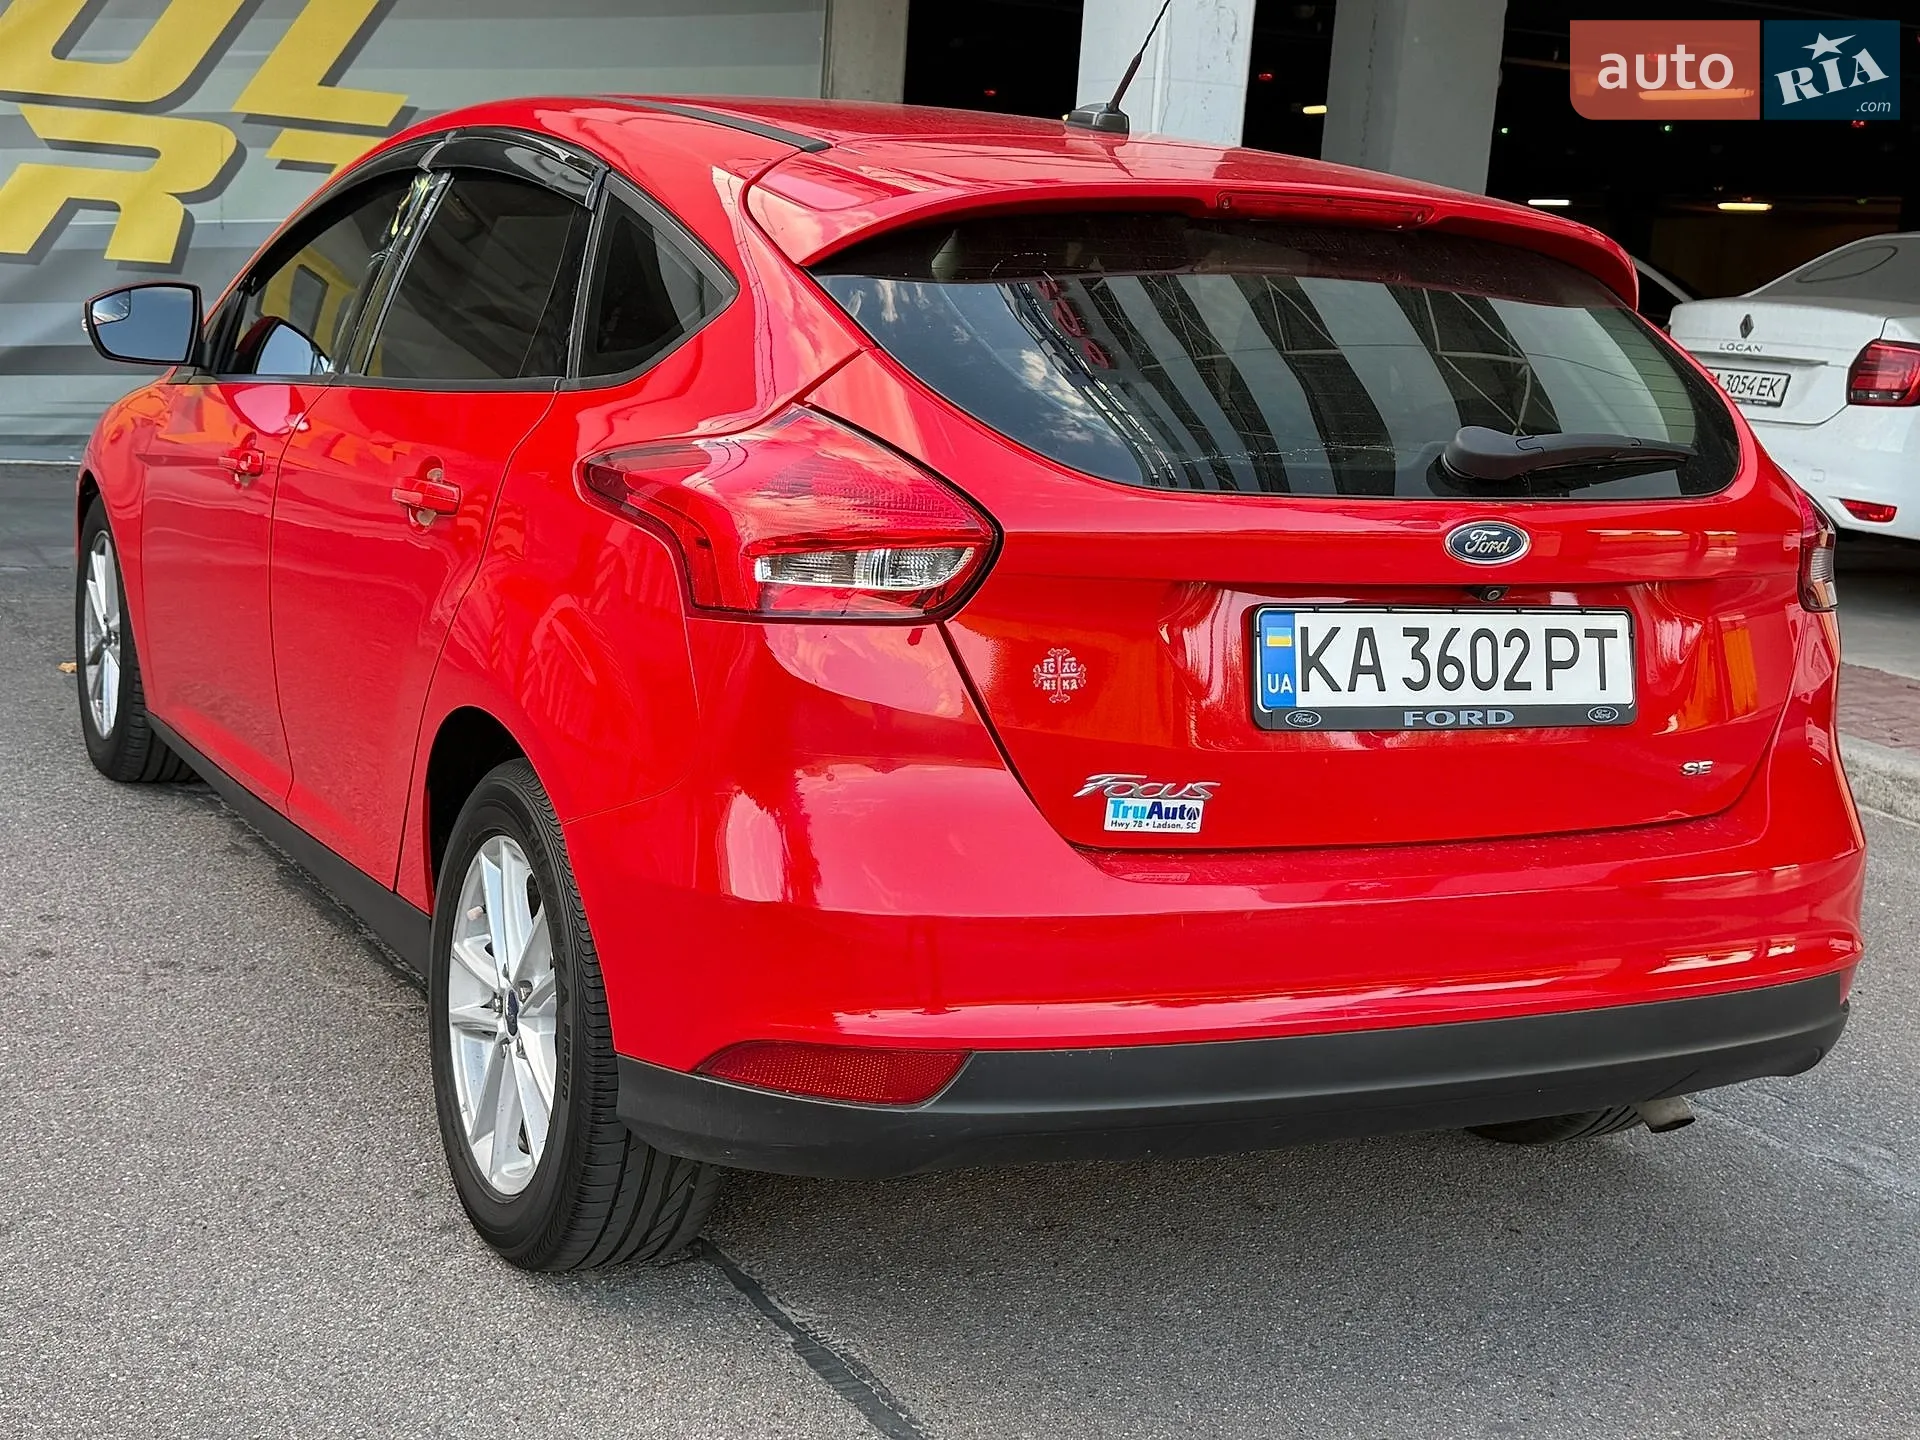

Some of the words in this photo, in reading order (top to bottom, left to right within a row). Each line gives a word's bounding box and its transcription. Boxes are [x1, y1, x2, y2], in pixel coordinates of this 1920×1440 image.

[1719, 343, 1763, 353] LOGAN
[1464, 529, 1510, 555] Ford
[1267, 674, 1293, 694] UA
[1403, 709, 1514, 727] FORD
[1682, 761, 1714, 776] SE
[1110, 799, 1200, 820] TruAuto
[1110, 820, 1130, 829] Hwy
[1133, 820, 1143, 828] 78
